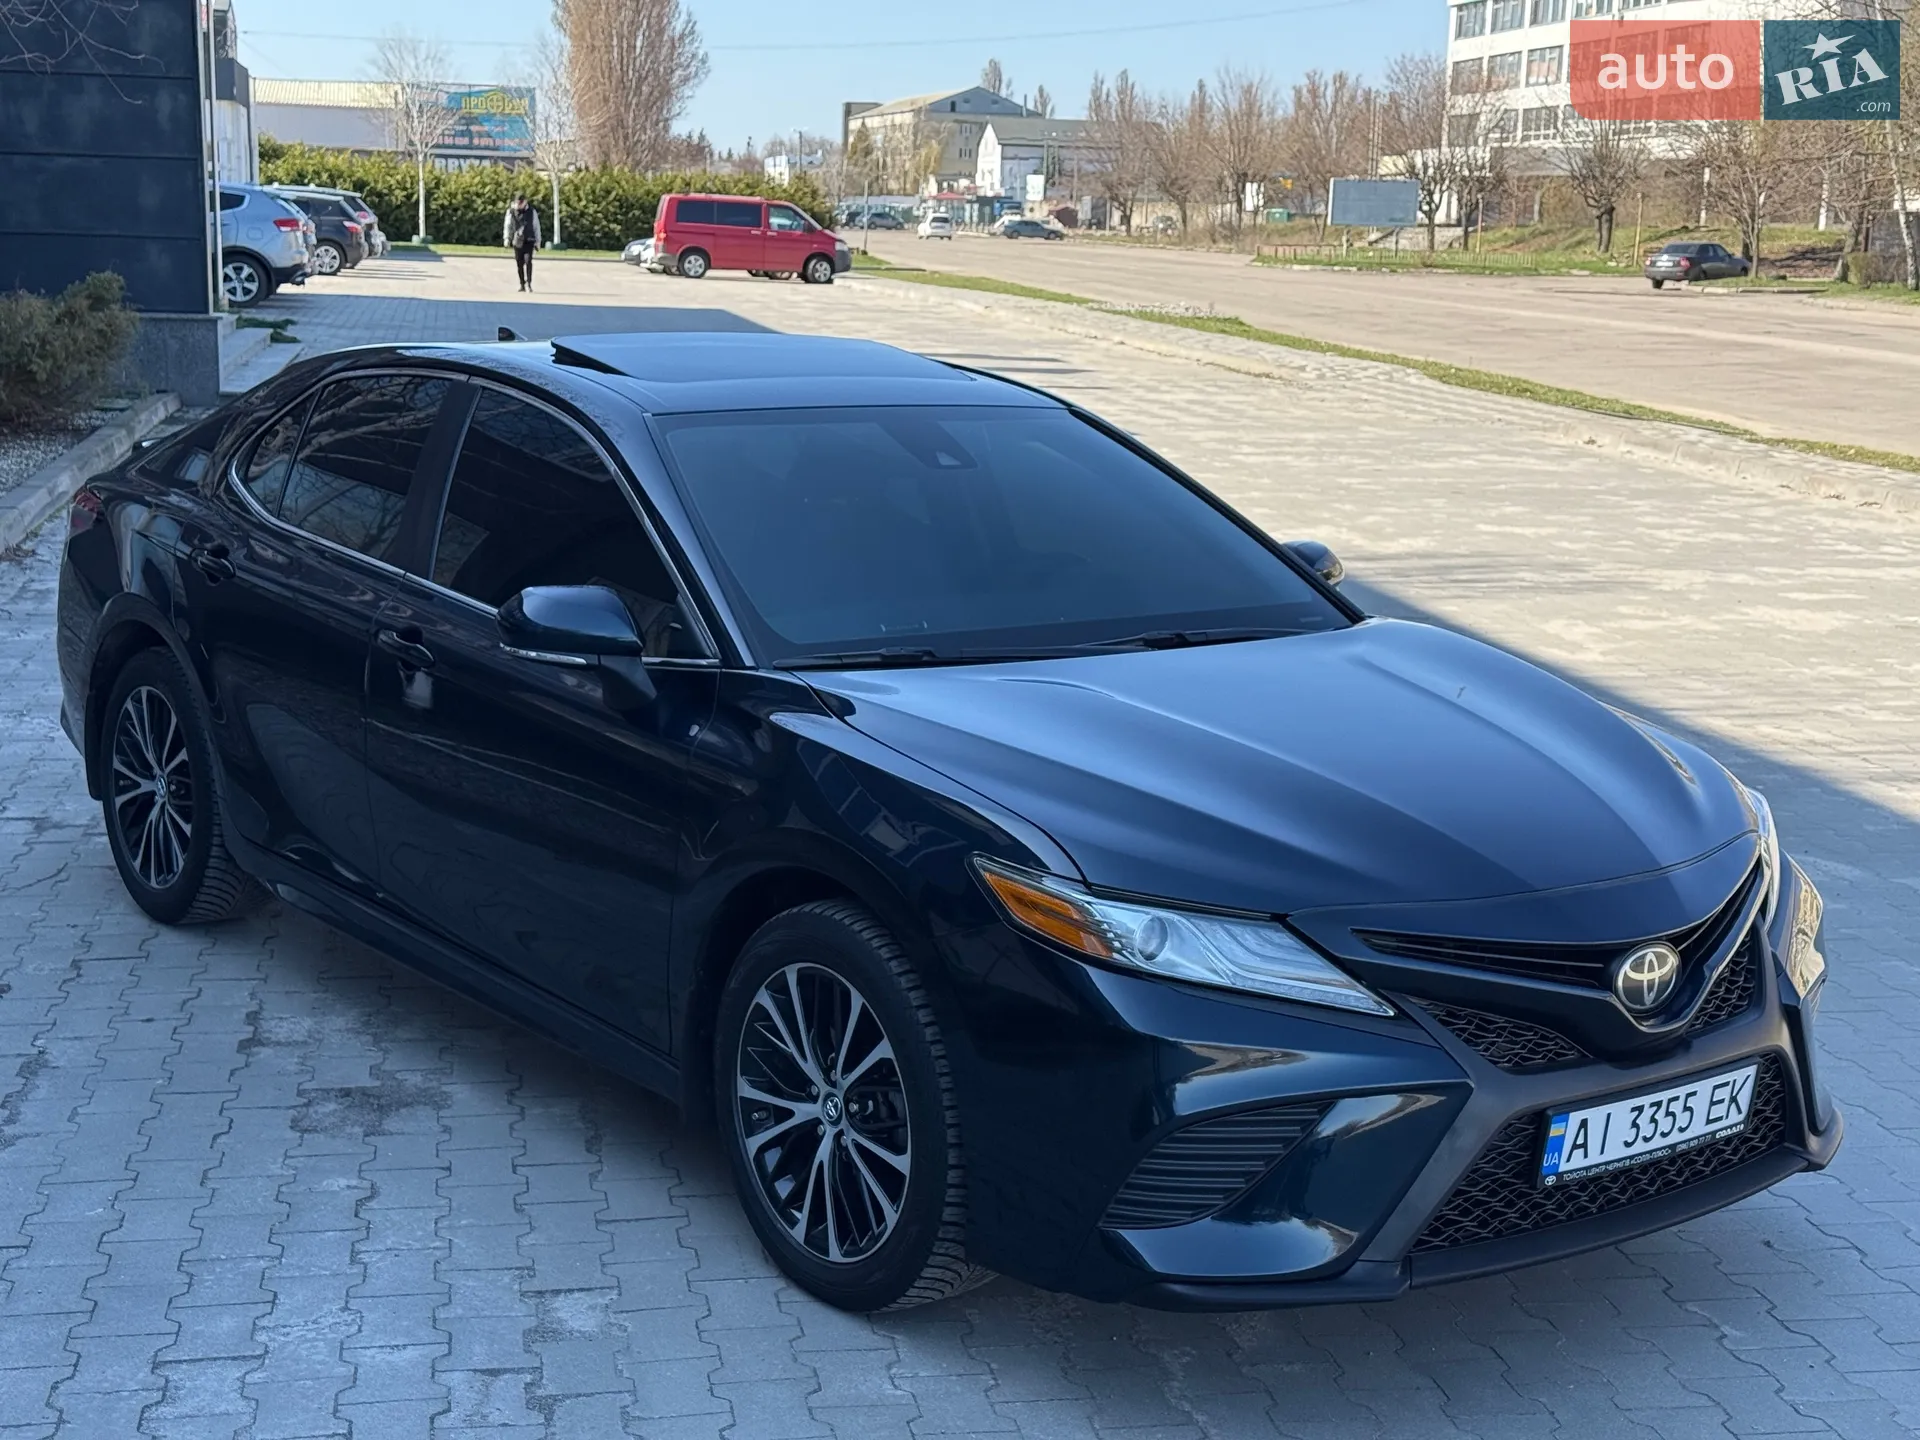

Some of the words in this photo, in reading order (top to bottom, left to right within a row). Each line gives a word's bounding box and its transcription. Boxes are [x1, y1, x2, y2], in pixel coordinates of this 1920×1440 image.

[1566, 1112, 1611, 1163] AI
[1623, 1090, 1698, 1148] 3355
[1704, 1074, 1751, 1126] EK
[1543, 1152, 1559, 1166] UA
